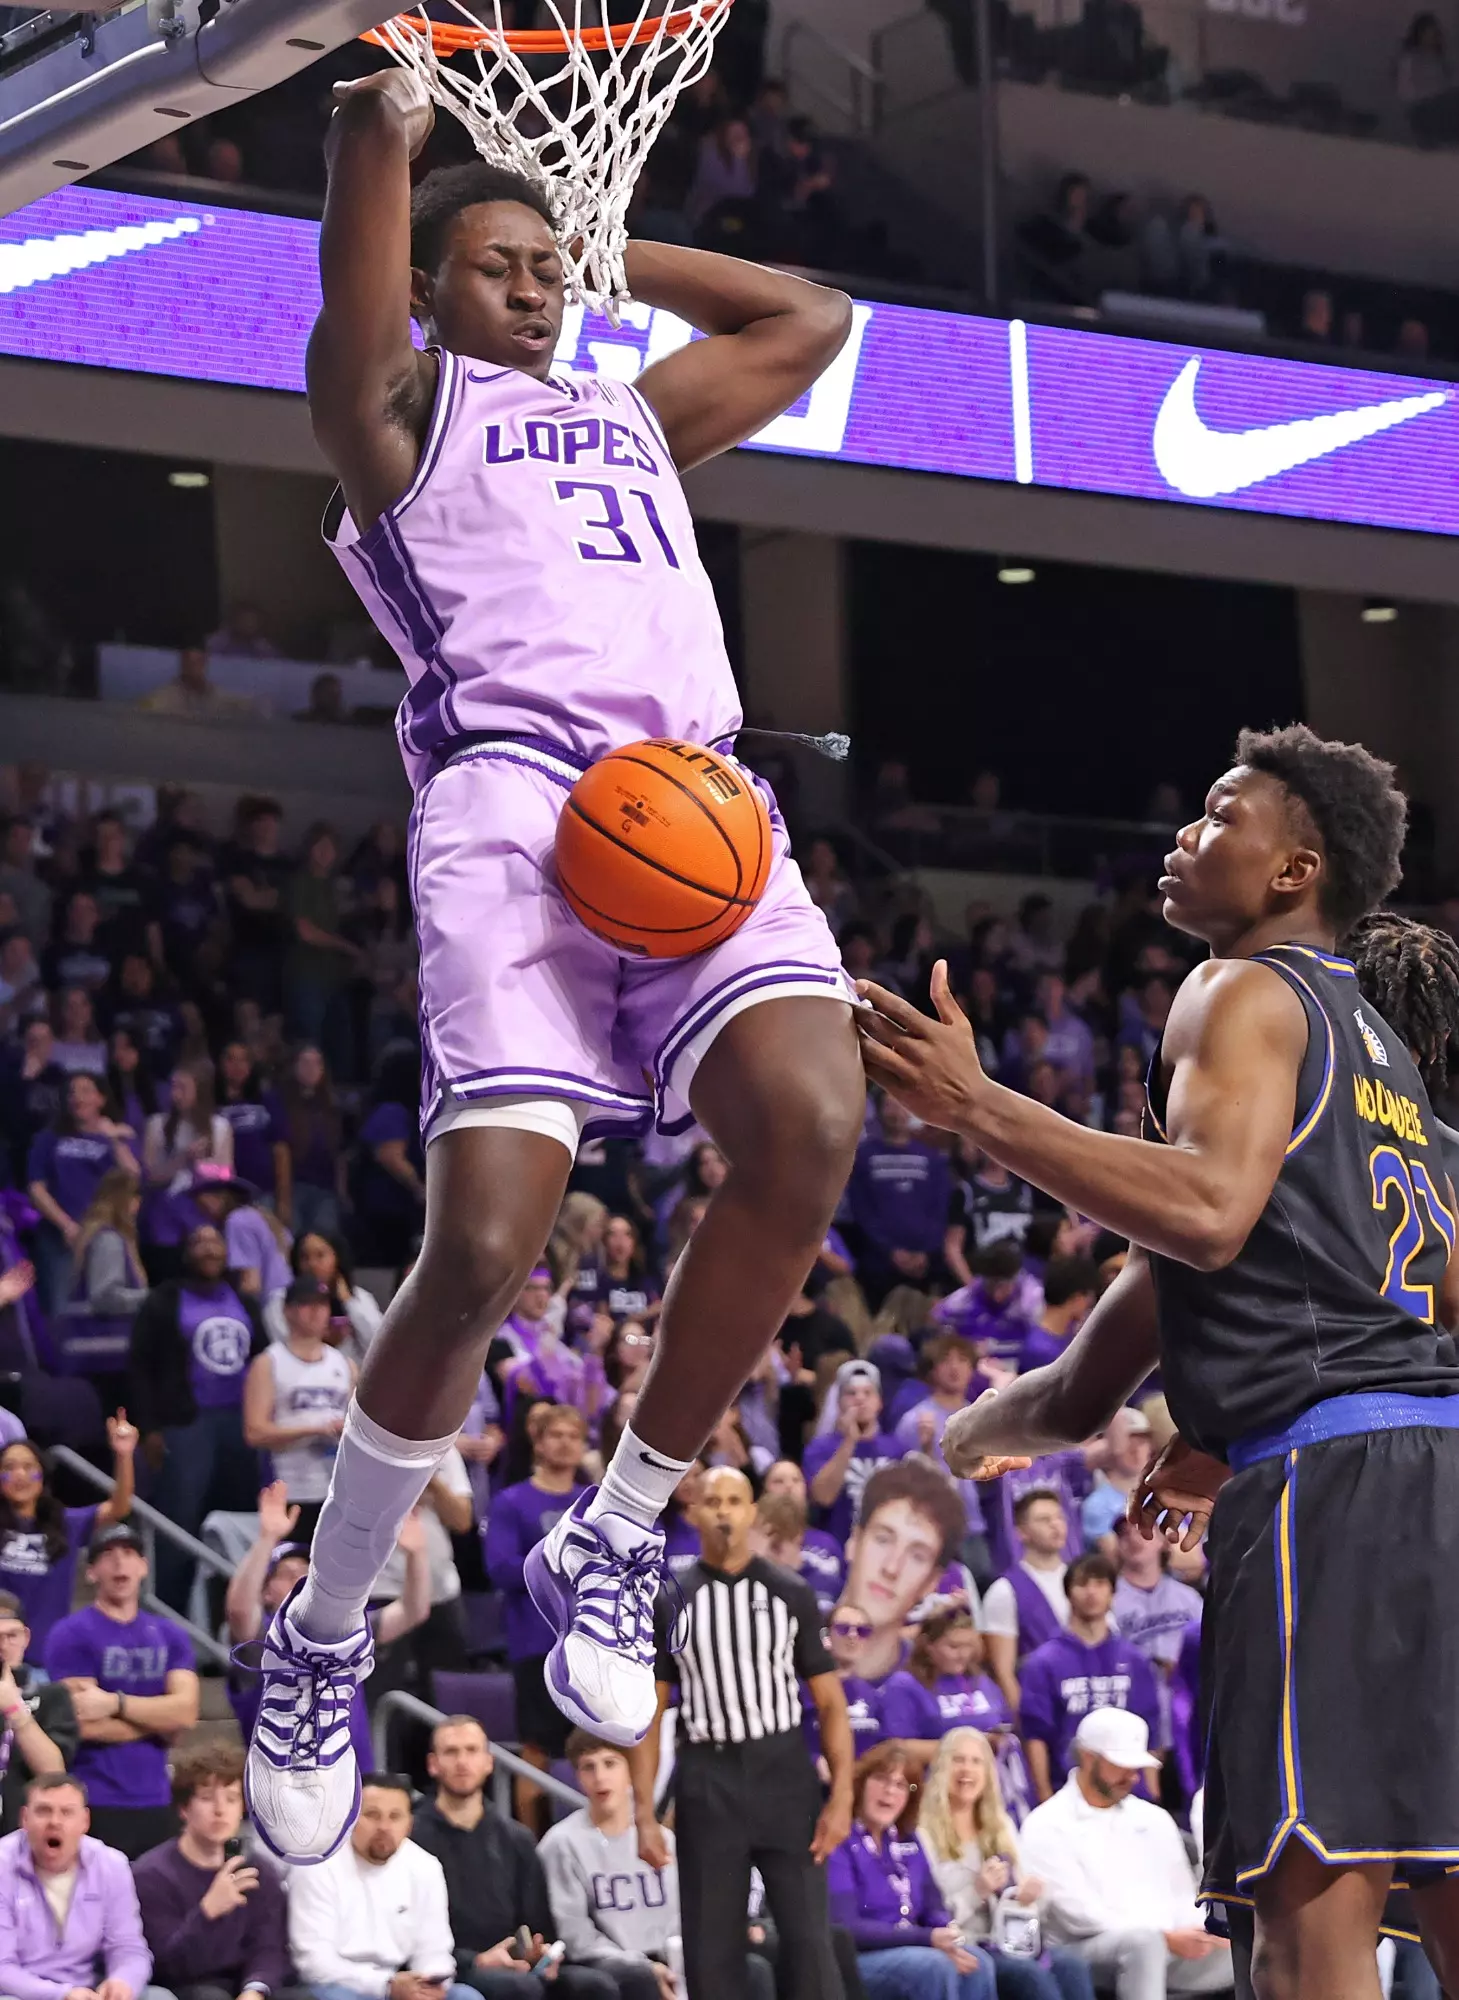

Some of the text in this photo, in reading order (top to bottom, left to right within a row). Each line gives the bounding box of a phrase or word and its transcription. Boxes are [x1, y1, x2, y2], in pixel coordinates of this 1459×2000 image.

[483, 416, 661, 479] LOPES
[550, 479, 682, 572] 31
[642, 739, 741, 800] ELITE
